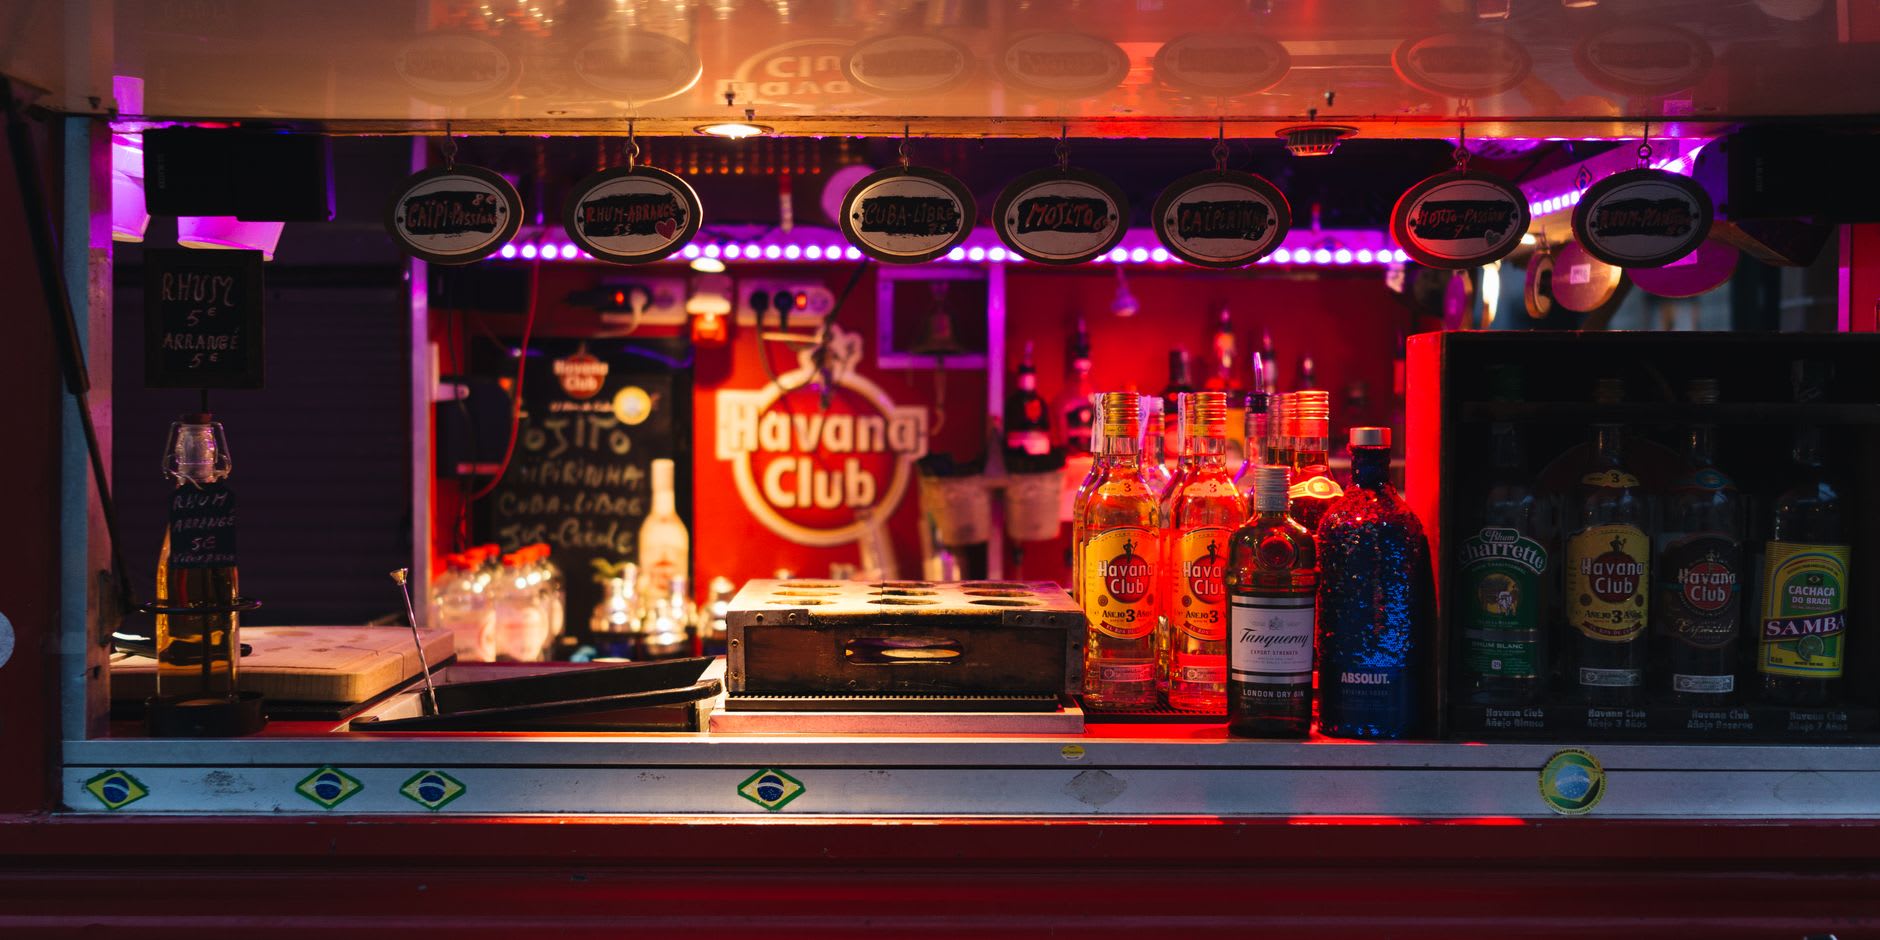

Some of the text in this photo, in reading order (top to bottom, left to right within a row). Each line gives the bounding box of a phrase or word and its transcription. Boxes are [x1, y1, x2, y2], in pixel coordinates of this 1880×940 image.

[161, 271, 236, 307] RHUM
[722, 400, 918, 453] Havana
[525, 416, 632, 458] OJITO
[763, 457, 876, 509] Club
[1610, 472, 1620, 484] 3
[1124, 482, 1132, 493] 3
[1209, 482, 1217, 493] 3
[1097, 560, 1153, 577] Havana
[1183, 561, 1223, 578] Hava
[1581, 558, 1644, 576] Havana
[1678, 567, 1736, 585] Havana
[1110, 578, 1144, 594] Club
[1595, 577, 1633, 594] Club
[1690, 585, 1726, 602] Club
[1806, 597, 1831, 605] BRAZIL
[1125, 608, 1136, 623] 3
[1209, 610, 1219, 624] 3
[1611, 609, 1622, 624] 3
[1766, 613, 1846, 636] SAMBA
[1239, 627, 1309, 648] Tanqueray
[1341, 671, 1390, 685] ABSOLUT.
[1243, 688, 1274, 698] LONDON
[1276, 690, 1291, 698] DRY
[1486, 708, 1544, 717] Havana Club
[1588, 708, 1623, 718] Havana
